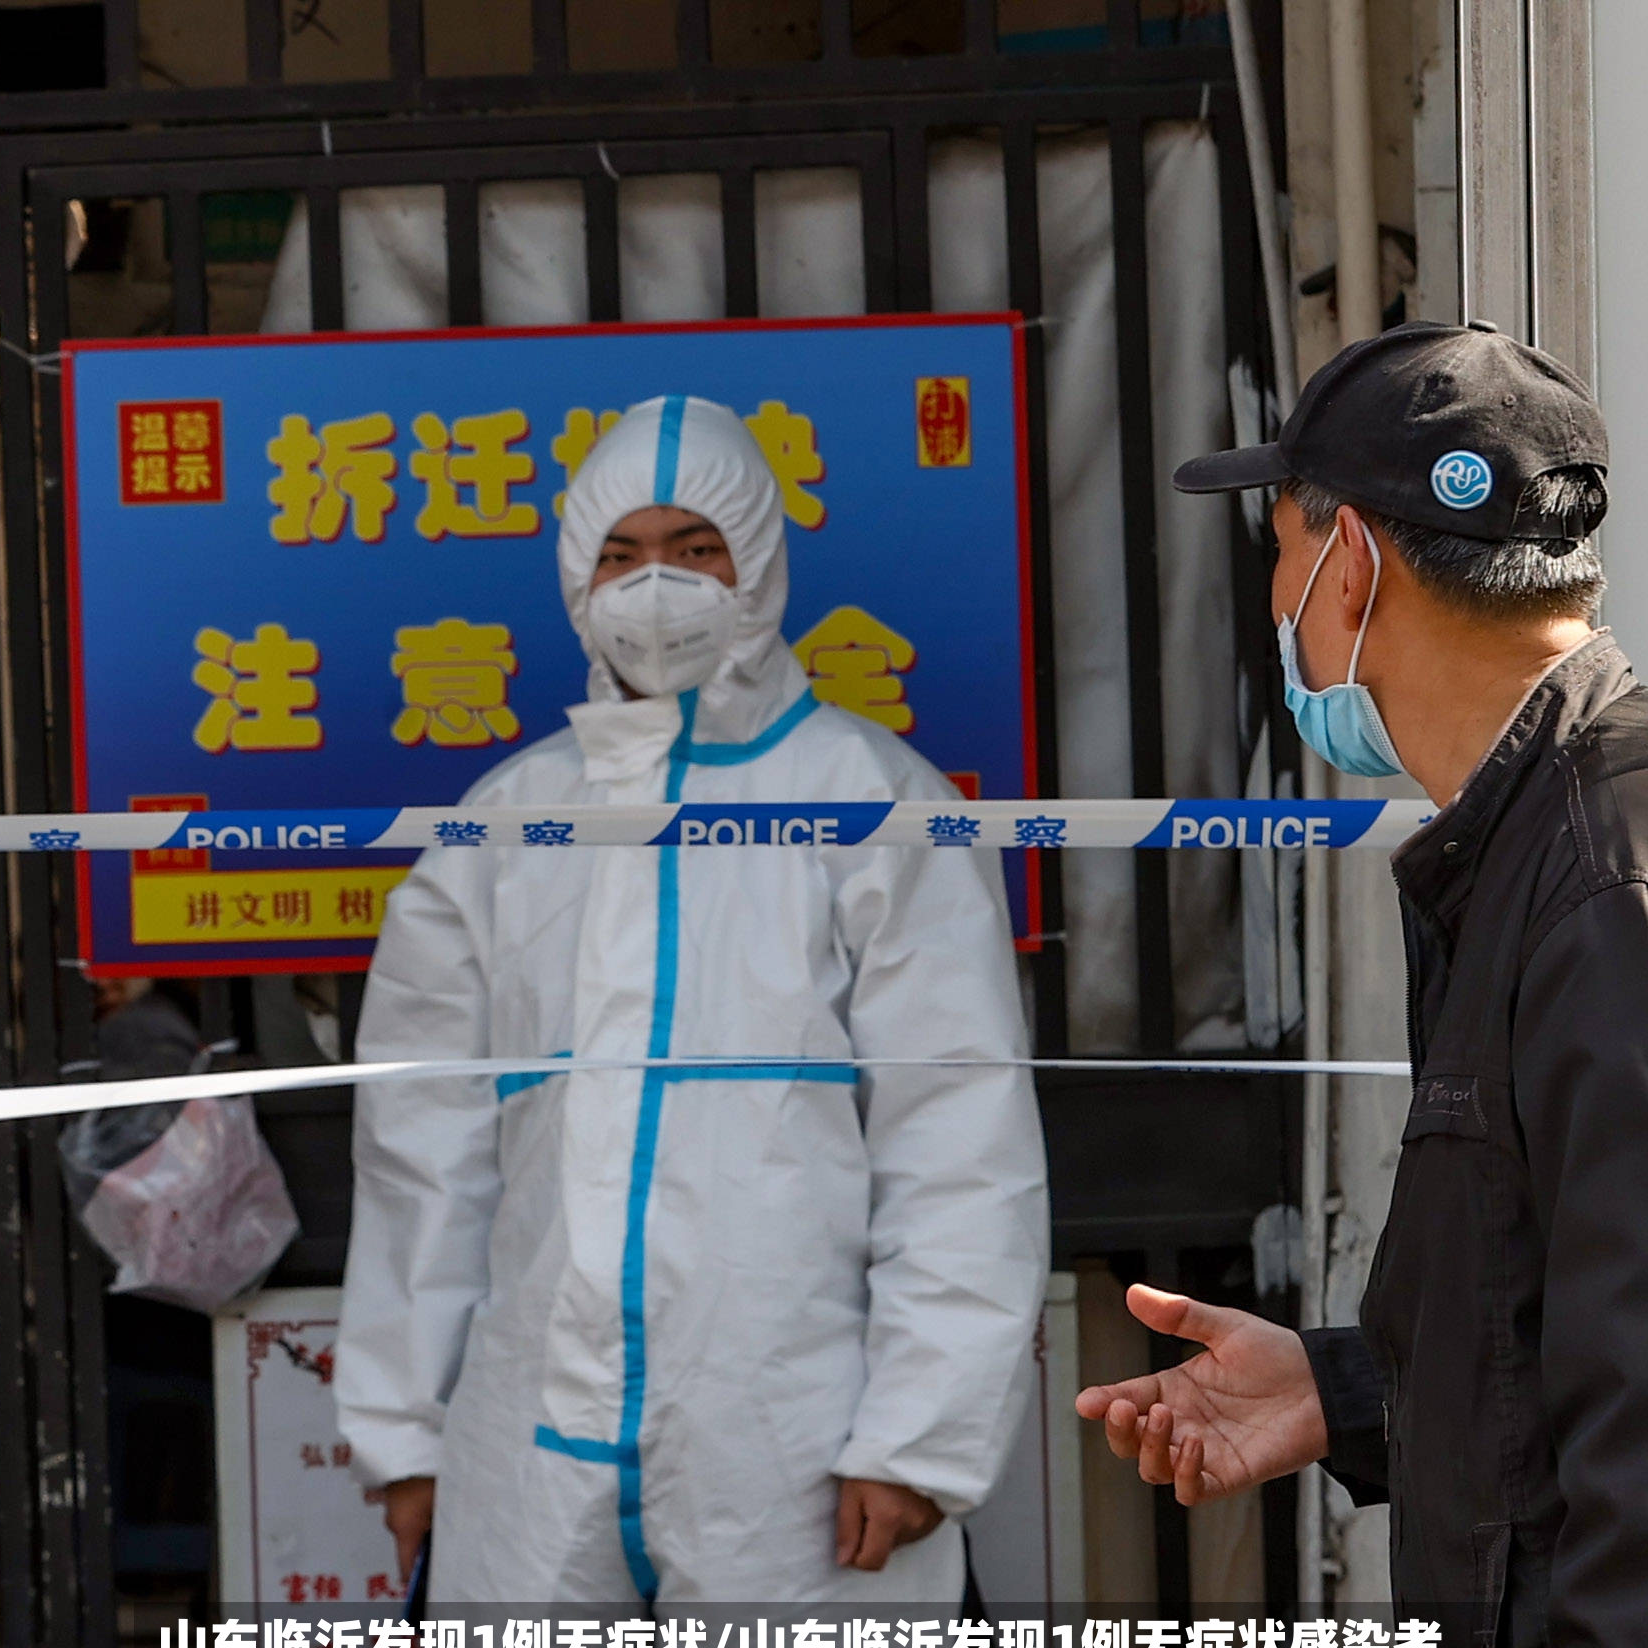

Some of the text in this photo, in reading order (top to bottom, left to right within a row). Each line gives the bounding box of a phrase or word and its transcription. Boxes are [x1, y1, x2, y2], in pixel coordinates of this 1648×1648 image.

[186, 824, 347, 849] POLICE
[679, 817, 839, 846] POLICE
[926, 815, 1067, 847] 警察
[1171, 816, 1332, 849] POLICE
[185, 889, 312, 929] 讲文明
